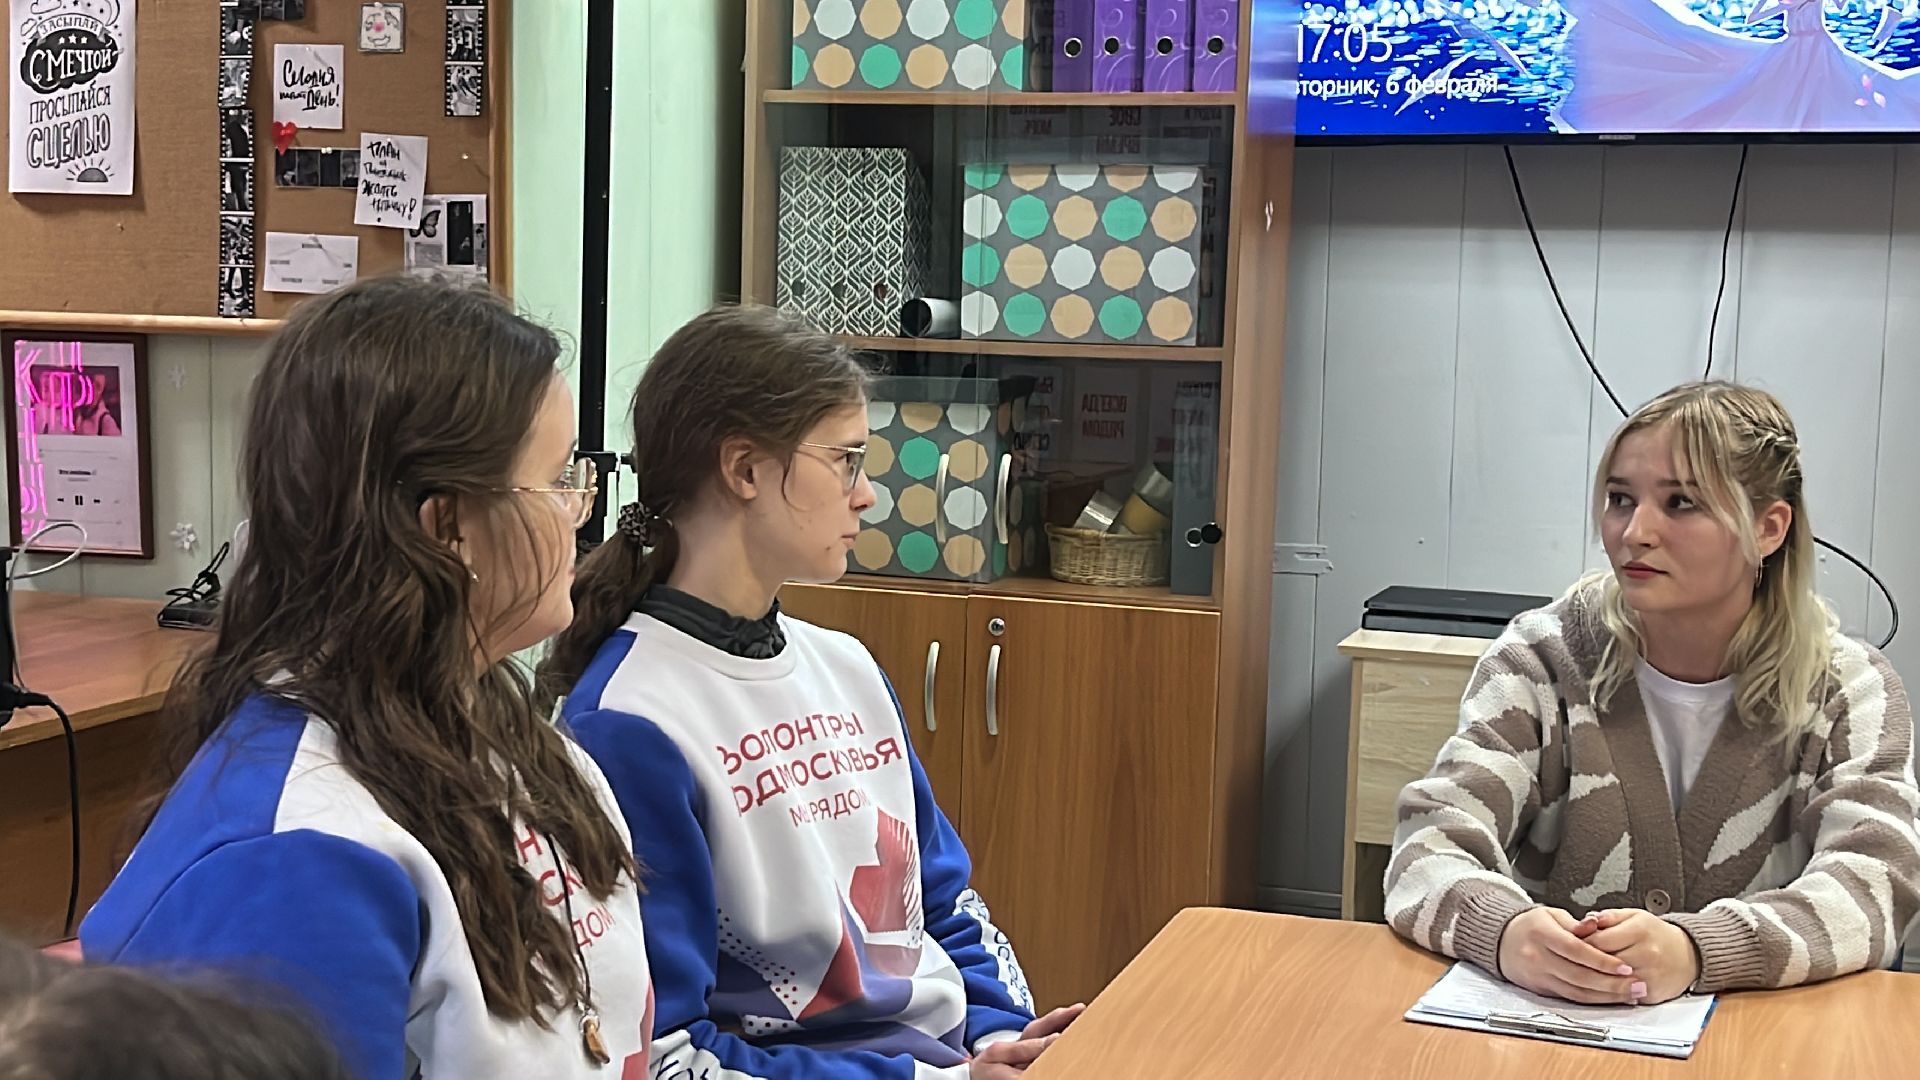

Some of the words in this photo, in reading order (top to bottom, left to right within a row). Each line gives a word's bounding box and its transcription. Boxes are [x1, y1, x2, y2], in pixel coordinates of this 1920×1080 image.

[39, 16, 99, 35] ЗАСЫПАЙ
[1297, 23, 1393, 63] 17:05
[29, 80, 111, 125] ПРОСЫПАЙСЯ
[1386, 73, 1400, 95] 6
[1404, 74, 1498, 99] февраля
